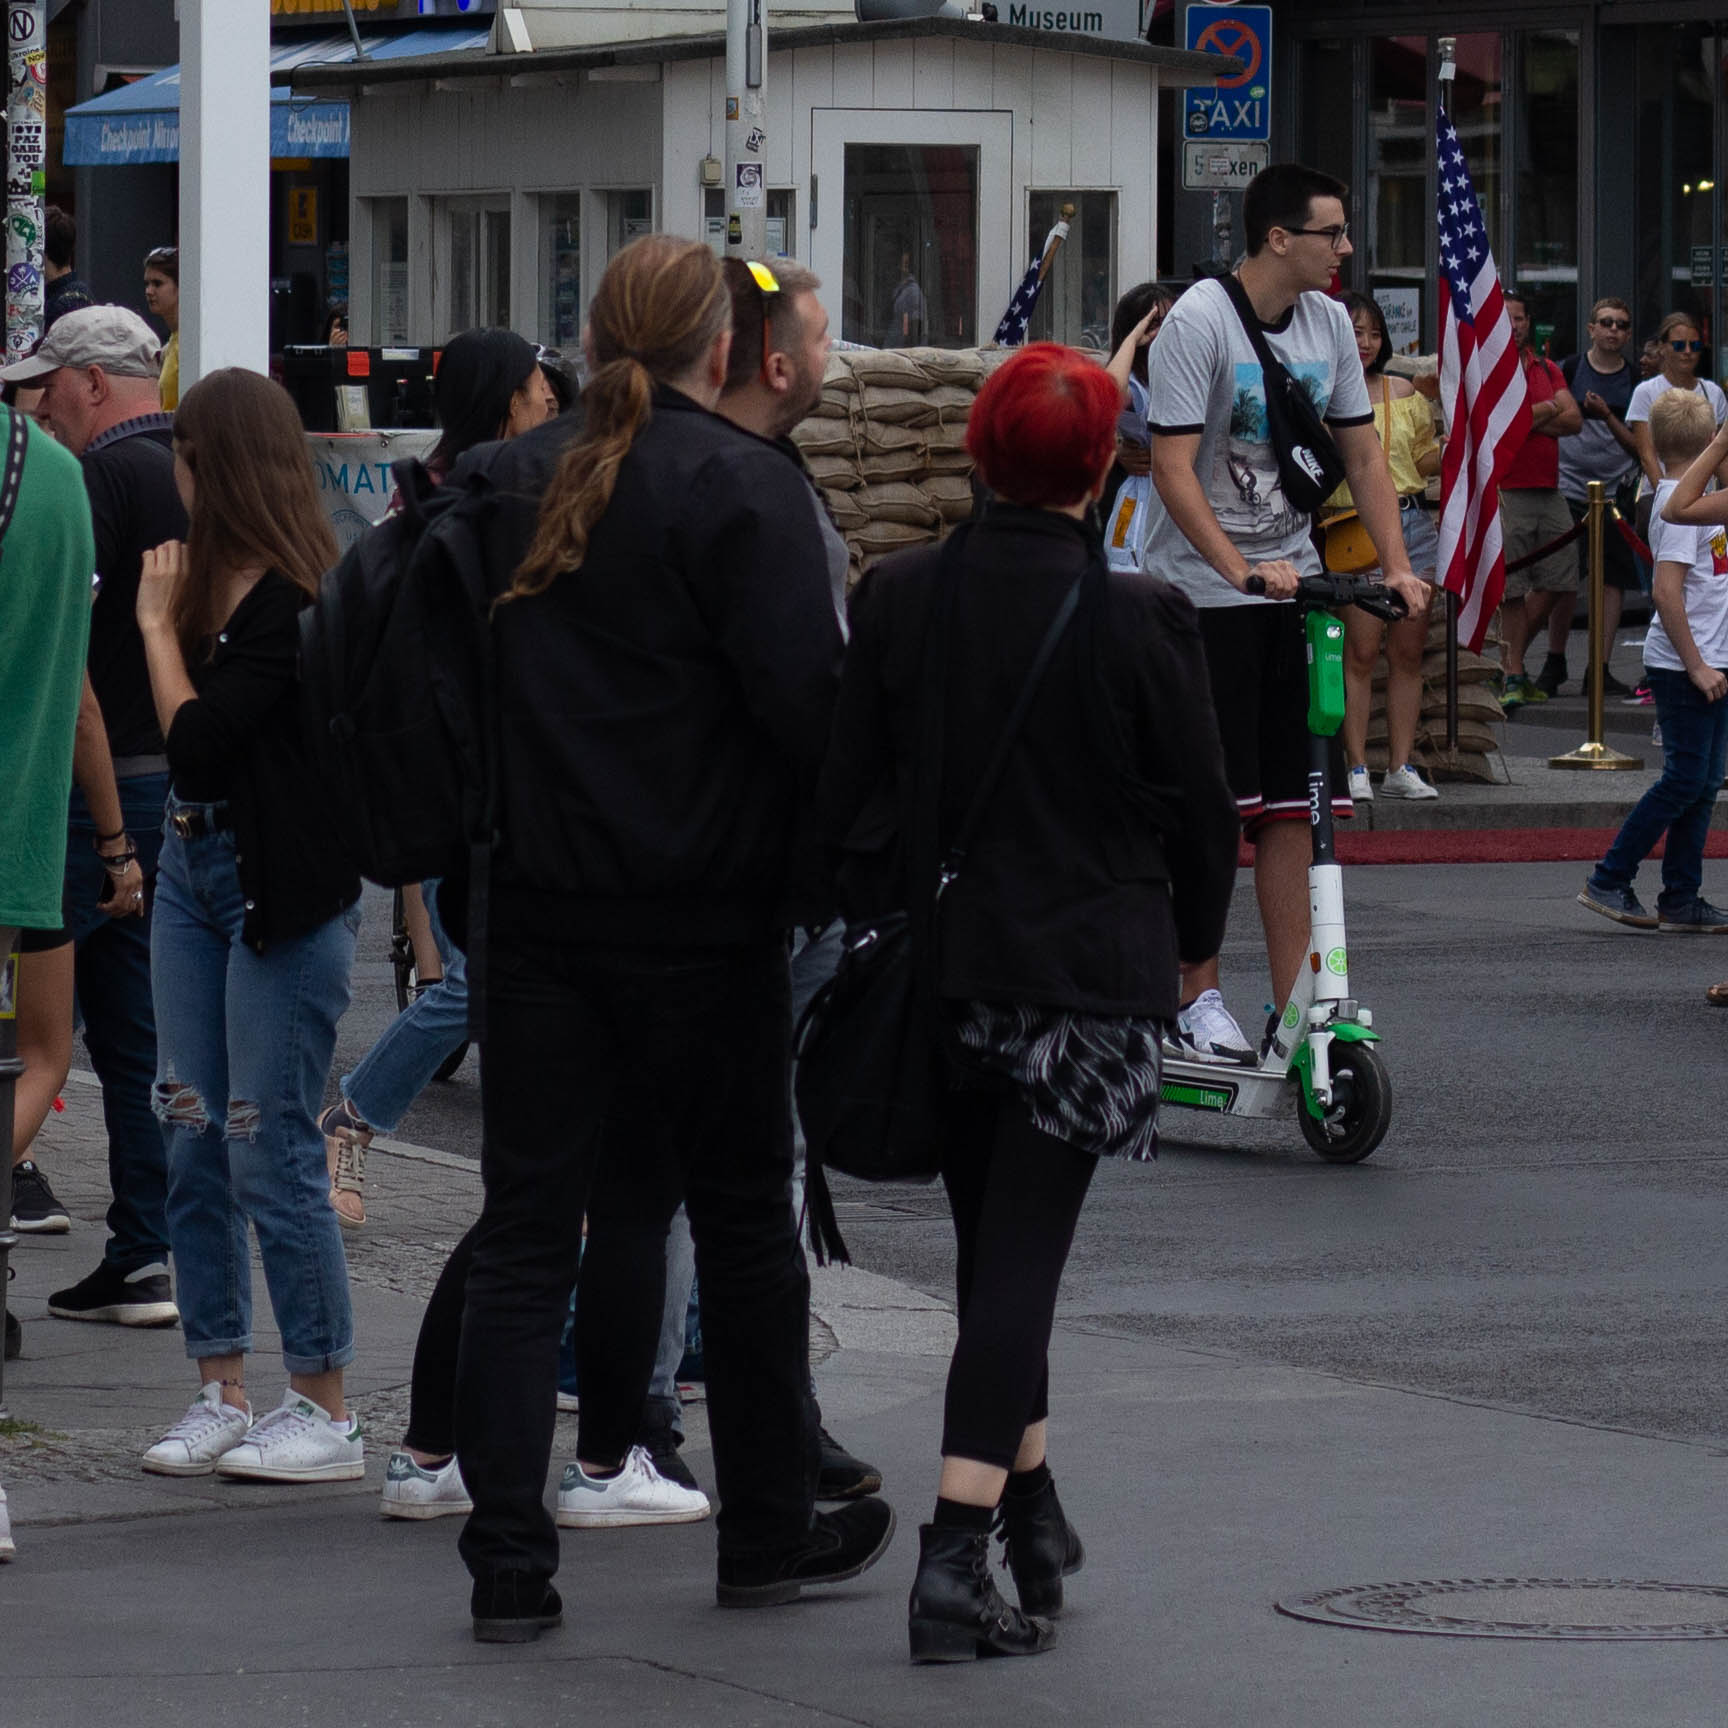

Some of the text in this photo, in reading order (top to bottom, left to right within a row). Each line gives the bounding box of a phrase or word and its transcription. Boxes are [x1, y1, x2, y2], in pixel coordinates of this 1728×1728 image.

[1009, 3, 1103, 32] Museum
[1193, 100, 1261, 129] TAXI
[1200, 1089, 1224, 1108] Lime
